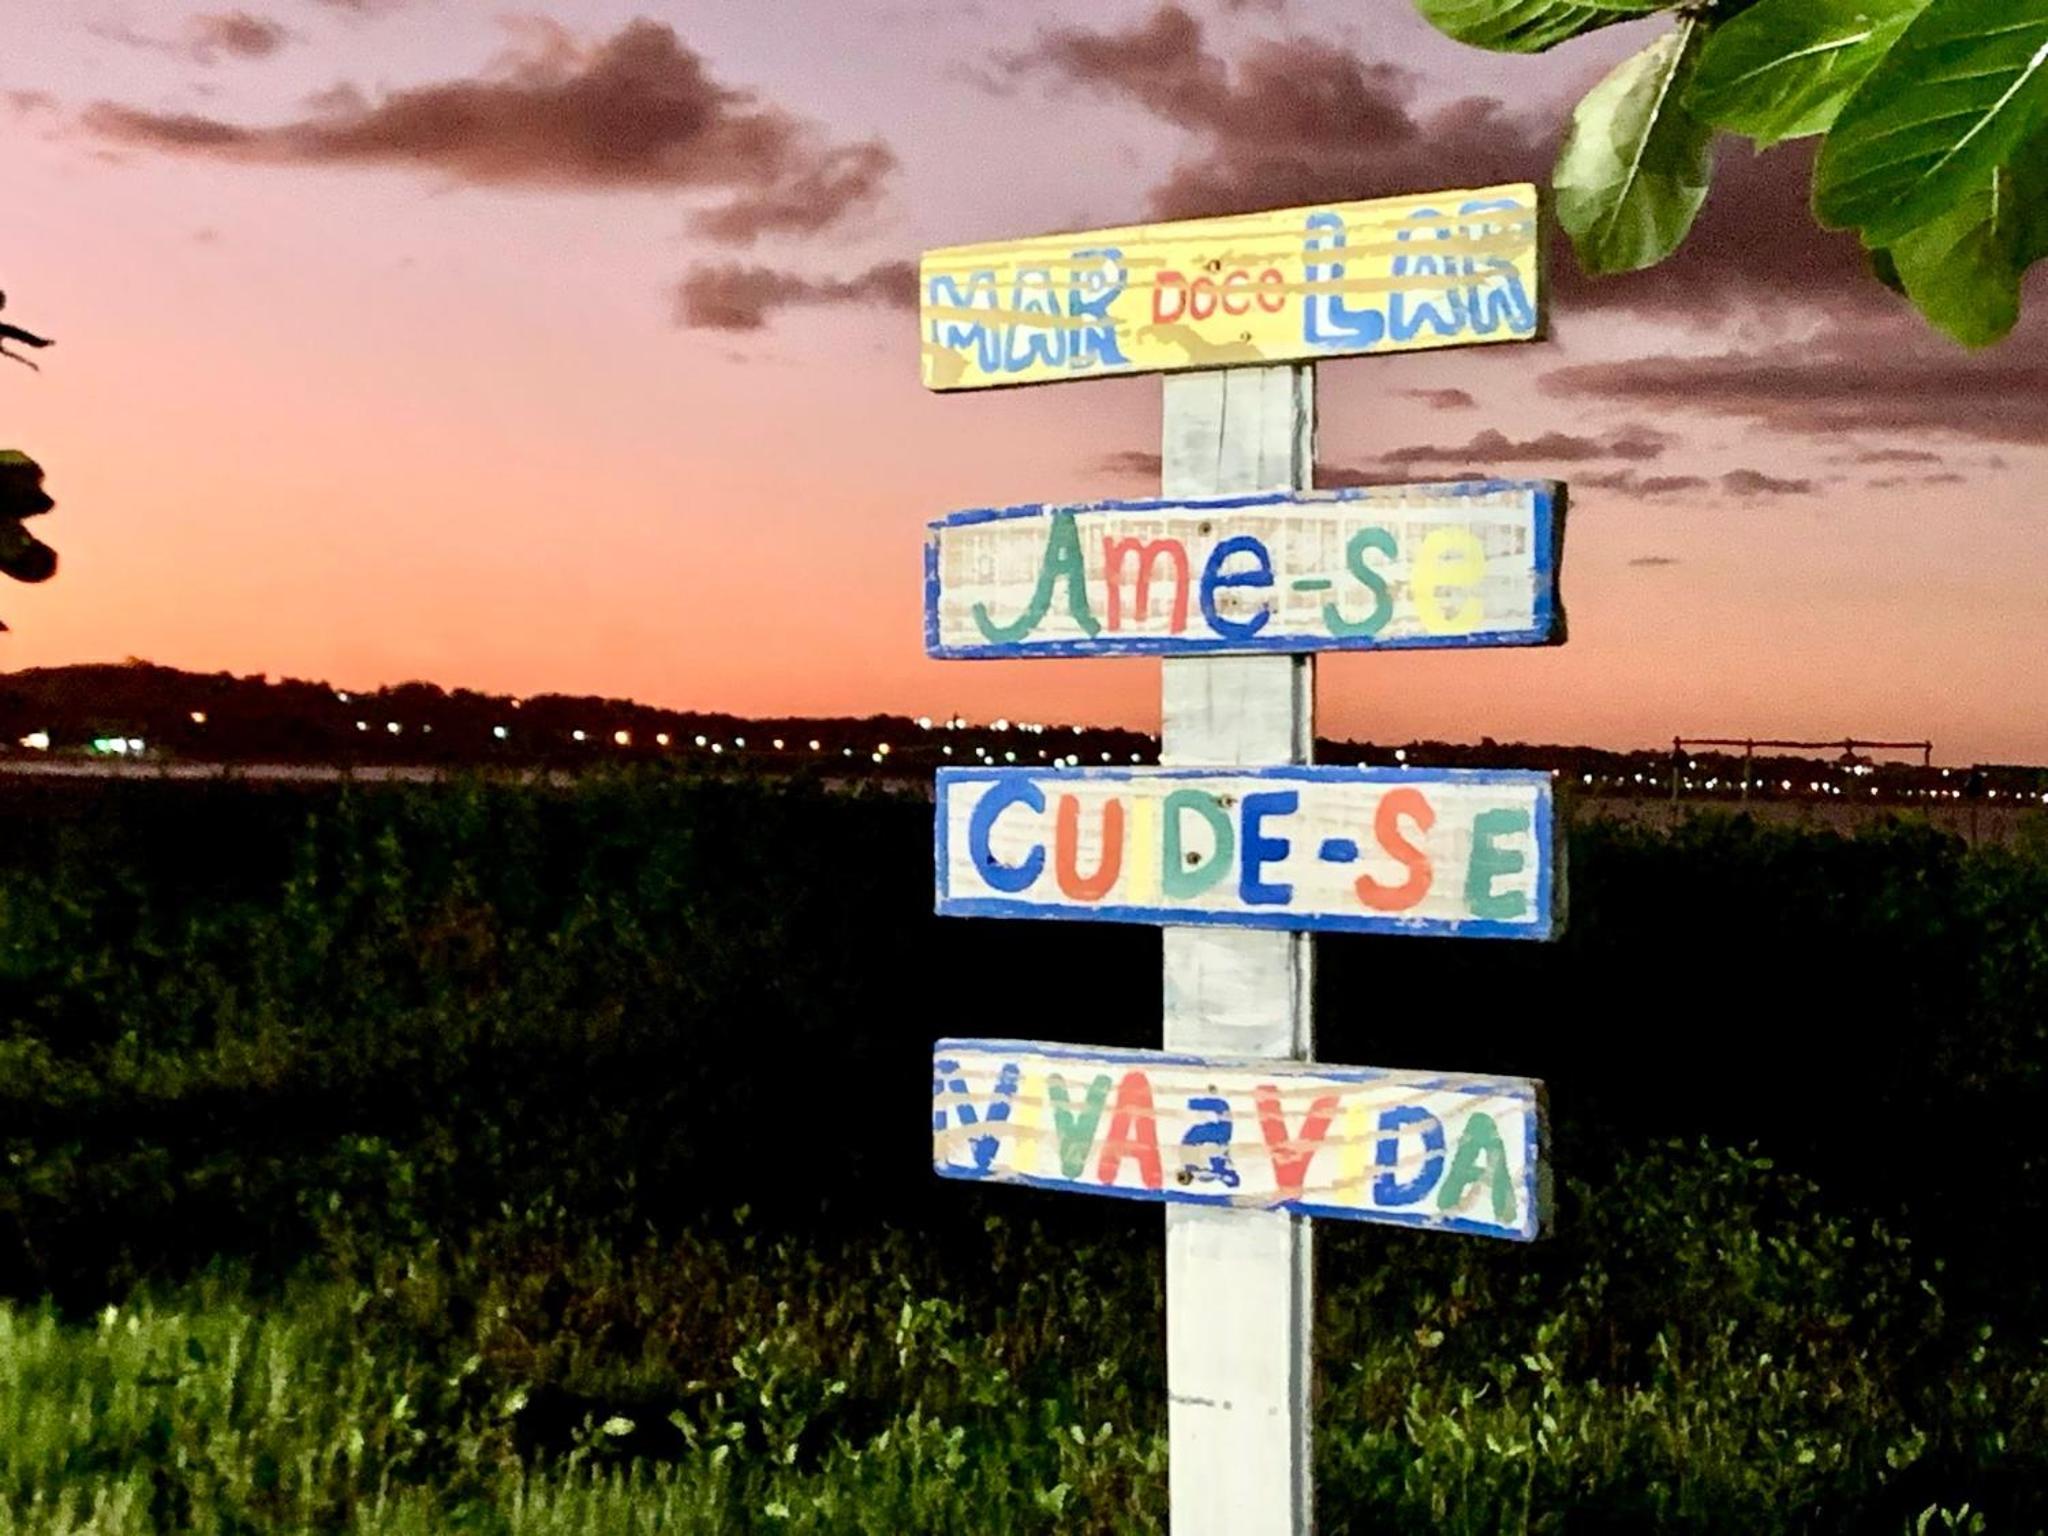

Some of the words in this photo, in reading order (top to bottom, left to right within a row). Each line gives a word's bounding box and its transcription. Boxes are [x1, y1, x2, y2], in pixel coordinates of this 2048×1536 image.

[929, 248, 1131, 373] MAR
[972, 508, 1488, 643] Ame-se
[968, 778, 1532, 921] CUIDE-SE
[936, 1056, 1164, 1190] VIVA
[1254, 1084, 1518, 1224] VIDA
